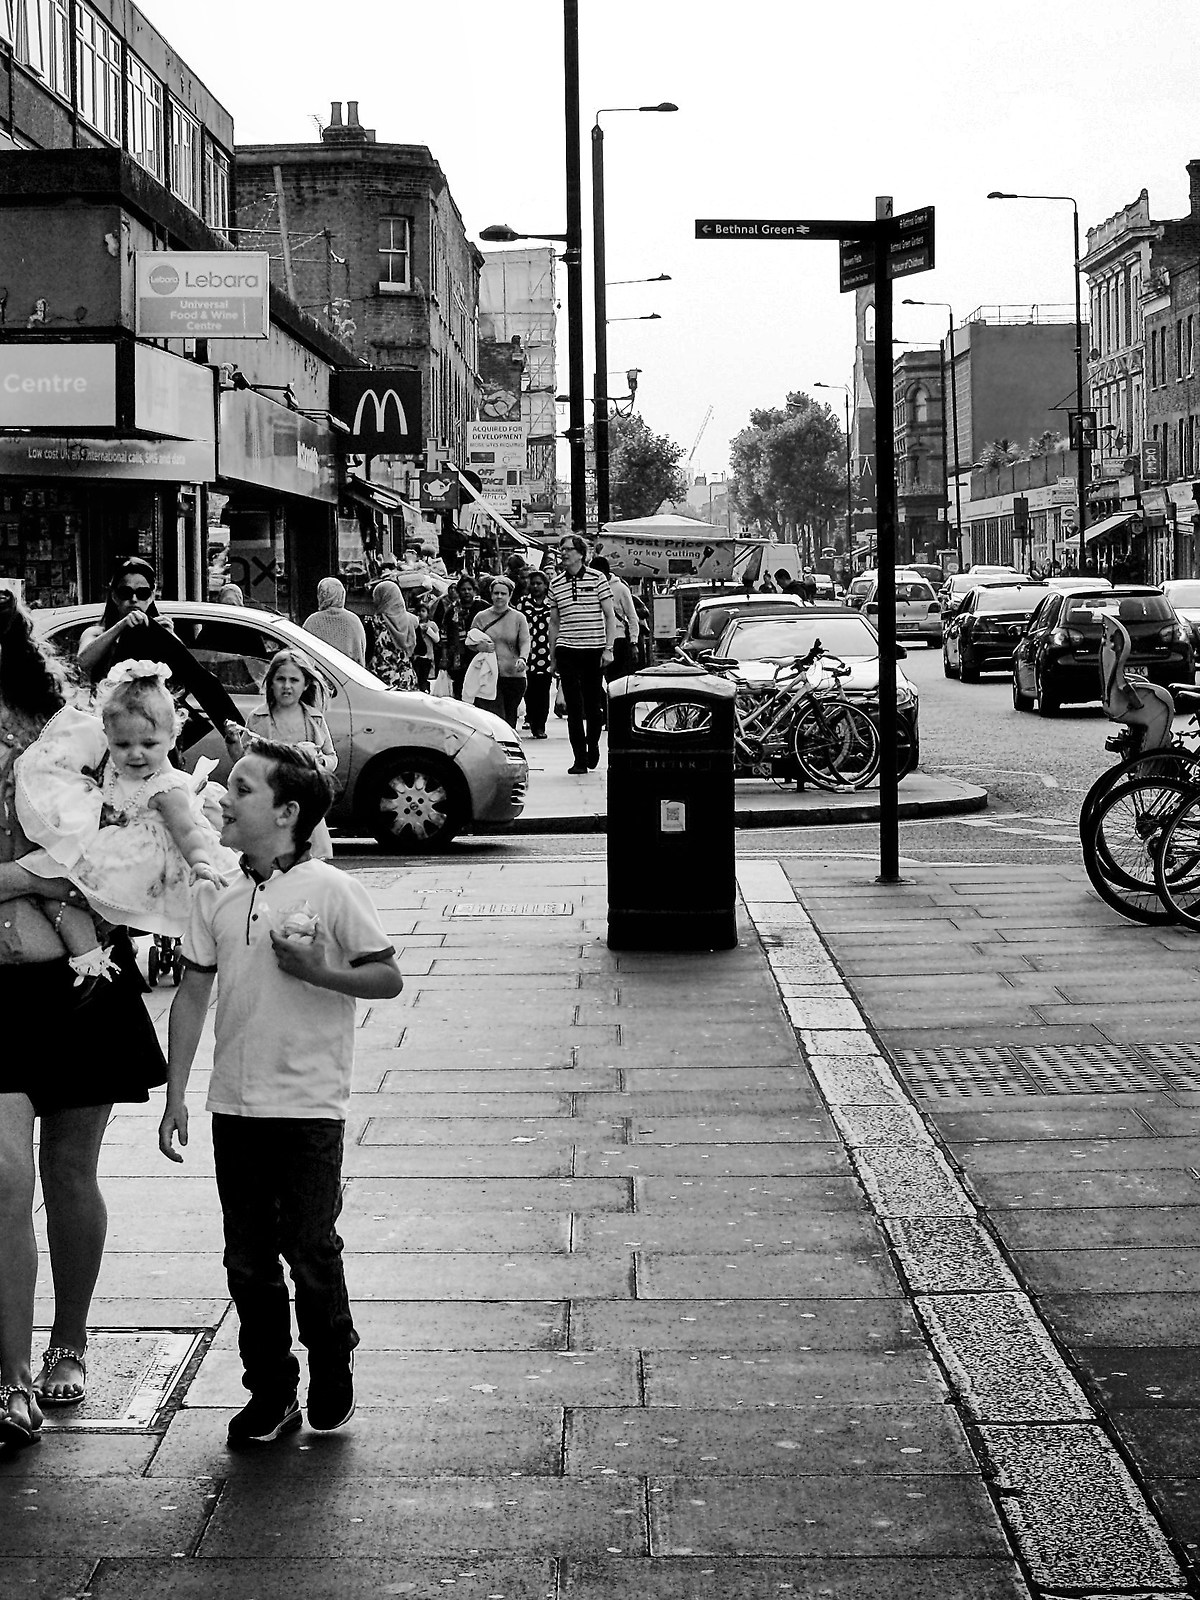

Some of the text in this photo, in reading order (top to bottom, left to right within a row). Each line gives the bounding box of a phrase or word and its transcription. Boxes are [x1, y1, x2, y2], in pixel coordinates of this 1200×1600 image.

[715, 224, 795, 235] Bethnal Green
[185, 271, 259, 288] Lebara
[180, 300, 229, 309] Universal
[170, 311, 239, 320] Food & Wine
[186, 321, 222, 331] Centre
[3, 373, 89, 394] Centre
[472, 425, 523, 433] ACQUIRED FOR
[28, 447, 42, 459] Low
[44, 449, 59, 459] cost
[382, 454, 425, 462] NEWS
[1145, 447, 1157, 474] CAFE
[625, 537, 704, 548] Best Price
[646, 549, 663, 558] key
[665, 550, 701, 559] Cutting
[645, 760, 697, 769] LITTER
